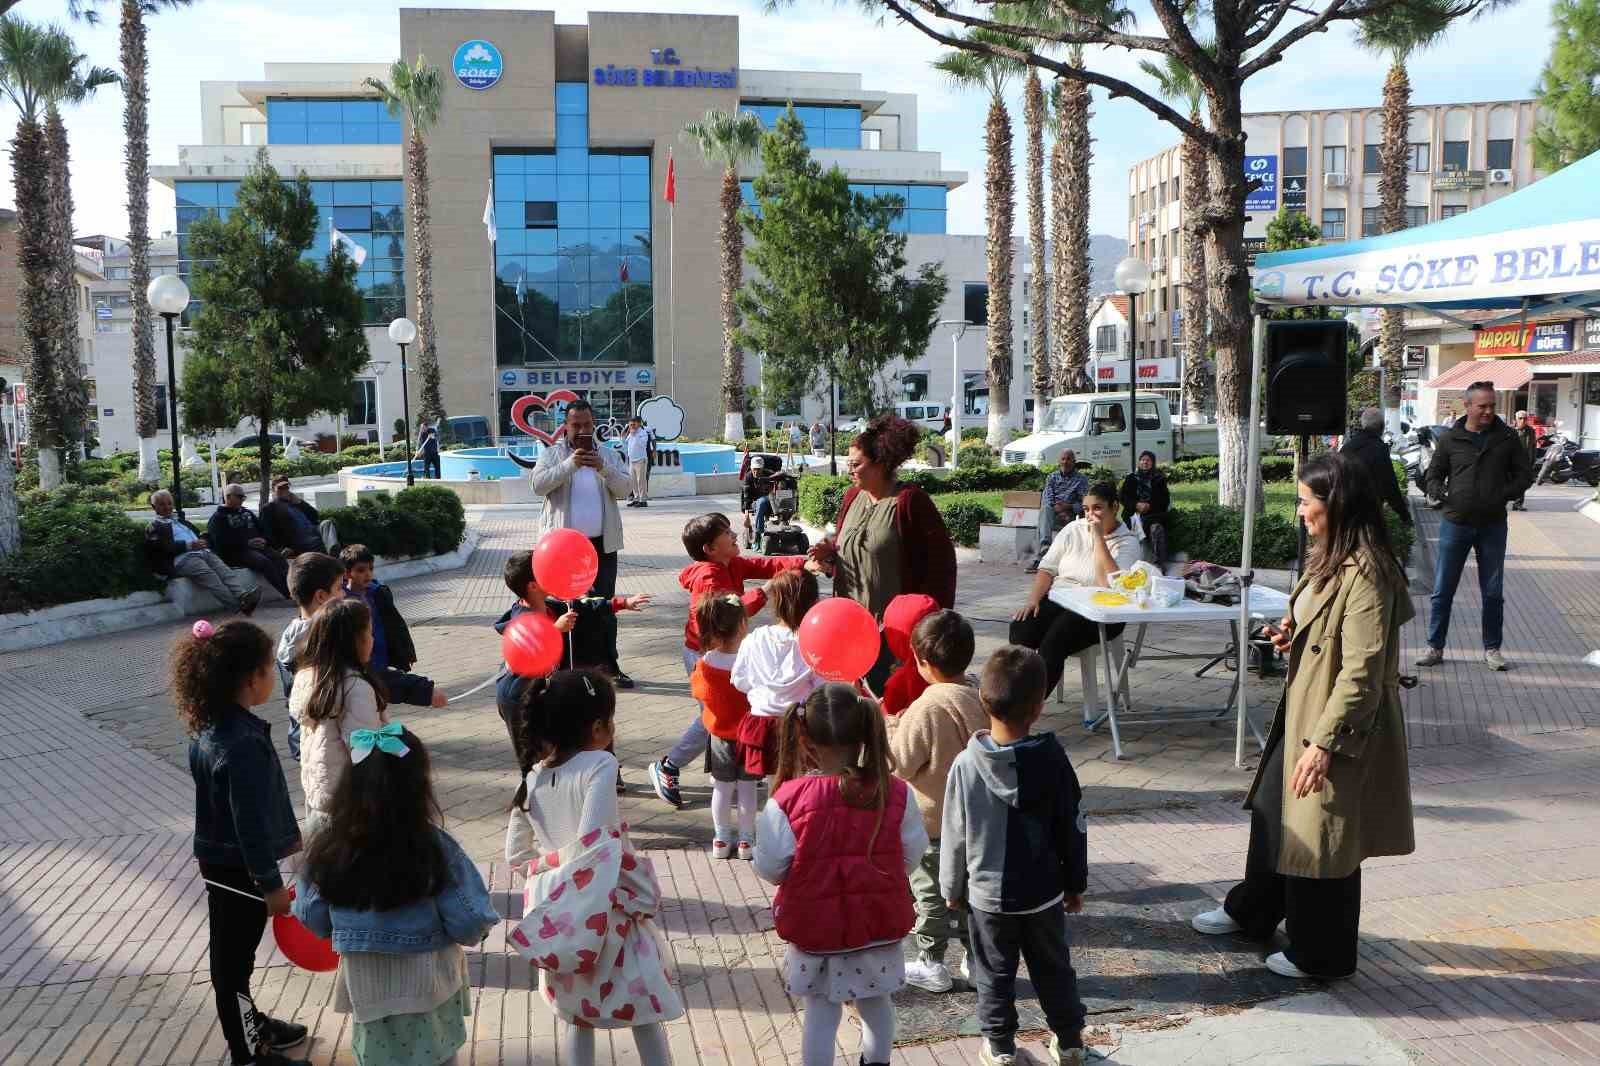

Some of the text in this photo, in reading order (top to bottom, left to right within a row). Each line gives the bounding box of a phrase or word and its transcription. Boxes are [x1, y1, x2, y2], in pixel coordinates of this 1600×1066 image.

[459, 67, 497, 77] SÖKE
[594, 64, 737, 88] SÖKE BELEDİYESİ
[1303, 270, 1361, 300] T.C.
[1376, 254, 1479, 294] SÖKE
[1535, 325, 1567, 336] TEKEL
[1479, 330, 1530, 349] HARPUT
[1537, 337, 1564, 350] BÜFE
